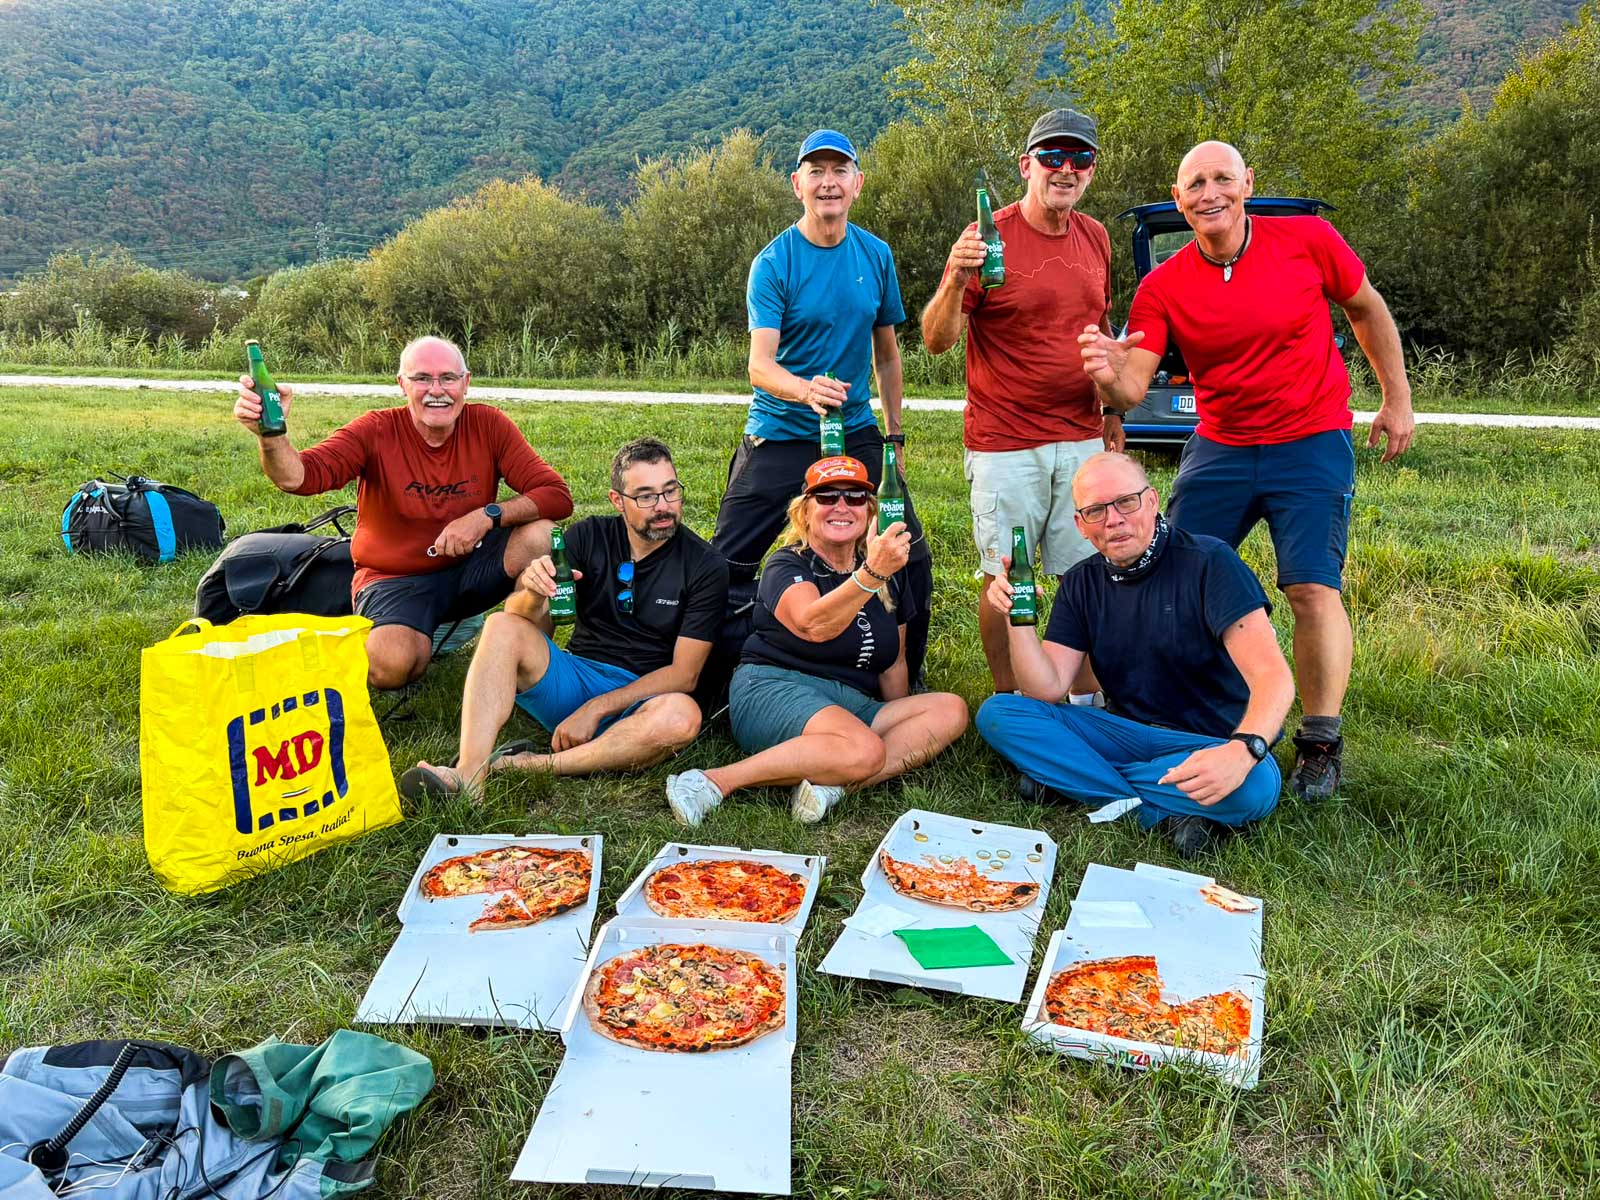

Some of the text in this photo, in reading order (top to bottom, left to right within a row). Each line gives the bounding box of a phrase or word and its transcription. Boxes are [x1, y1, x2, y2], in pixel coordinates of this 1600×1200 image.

[405, 480, 469, 496] RVRC
[252, 730, 324, 787] MD
[237, 841, 275, 861] Buona
[278, 830, 317, 846] Spesa,
